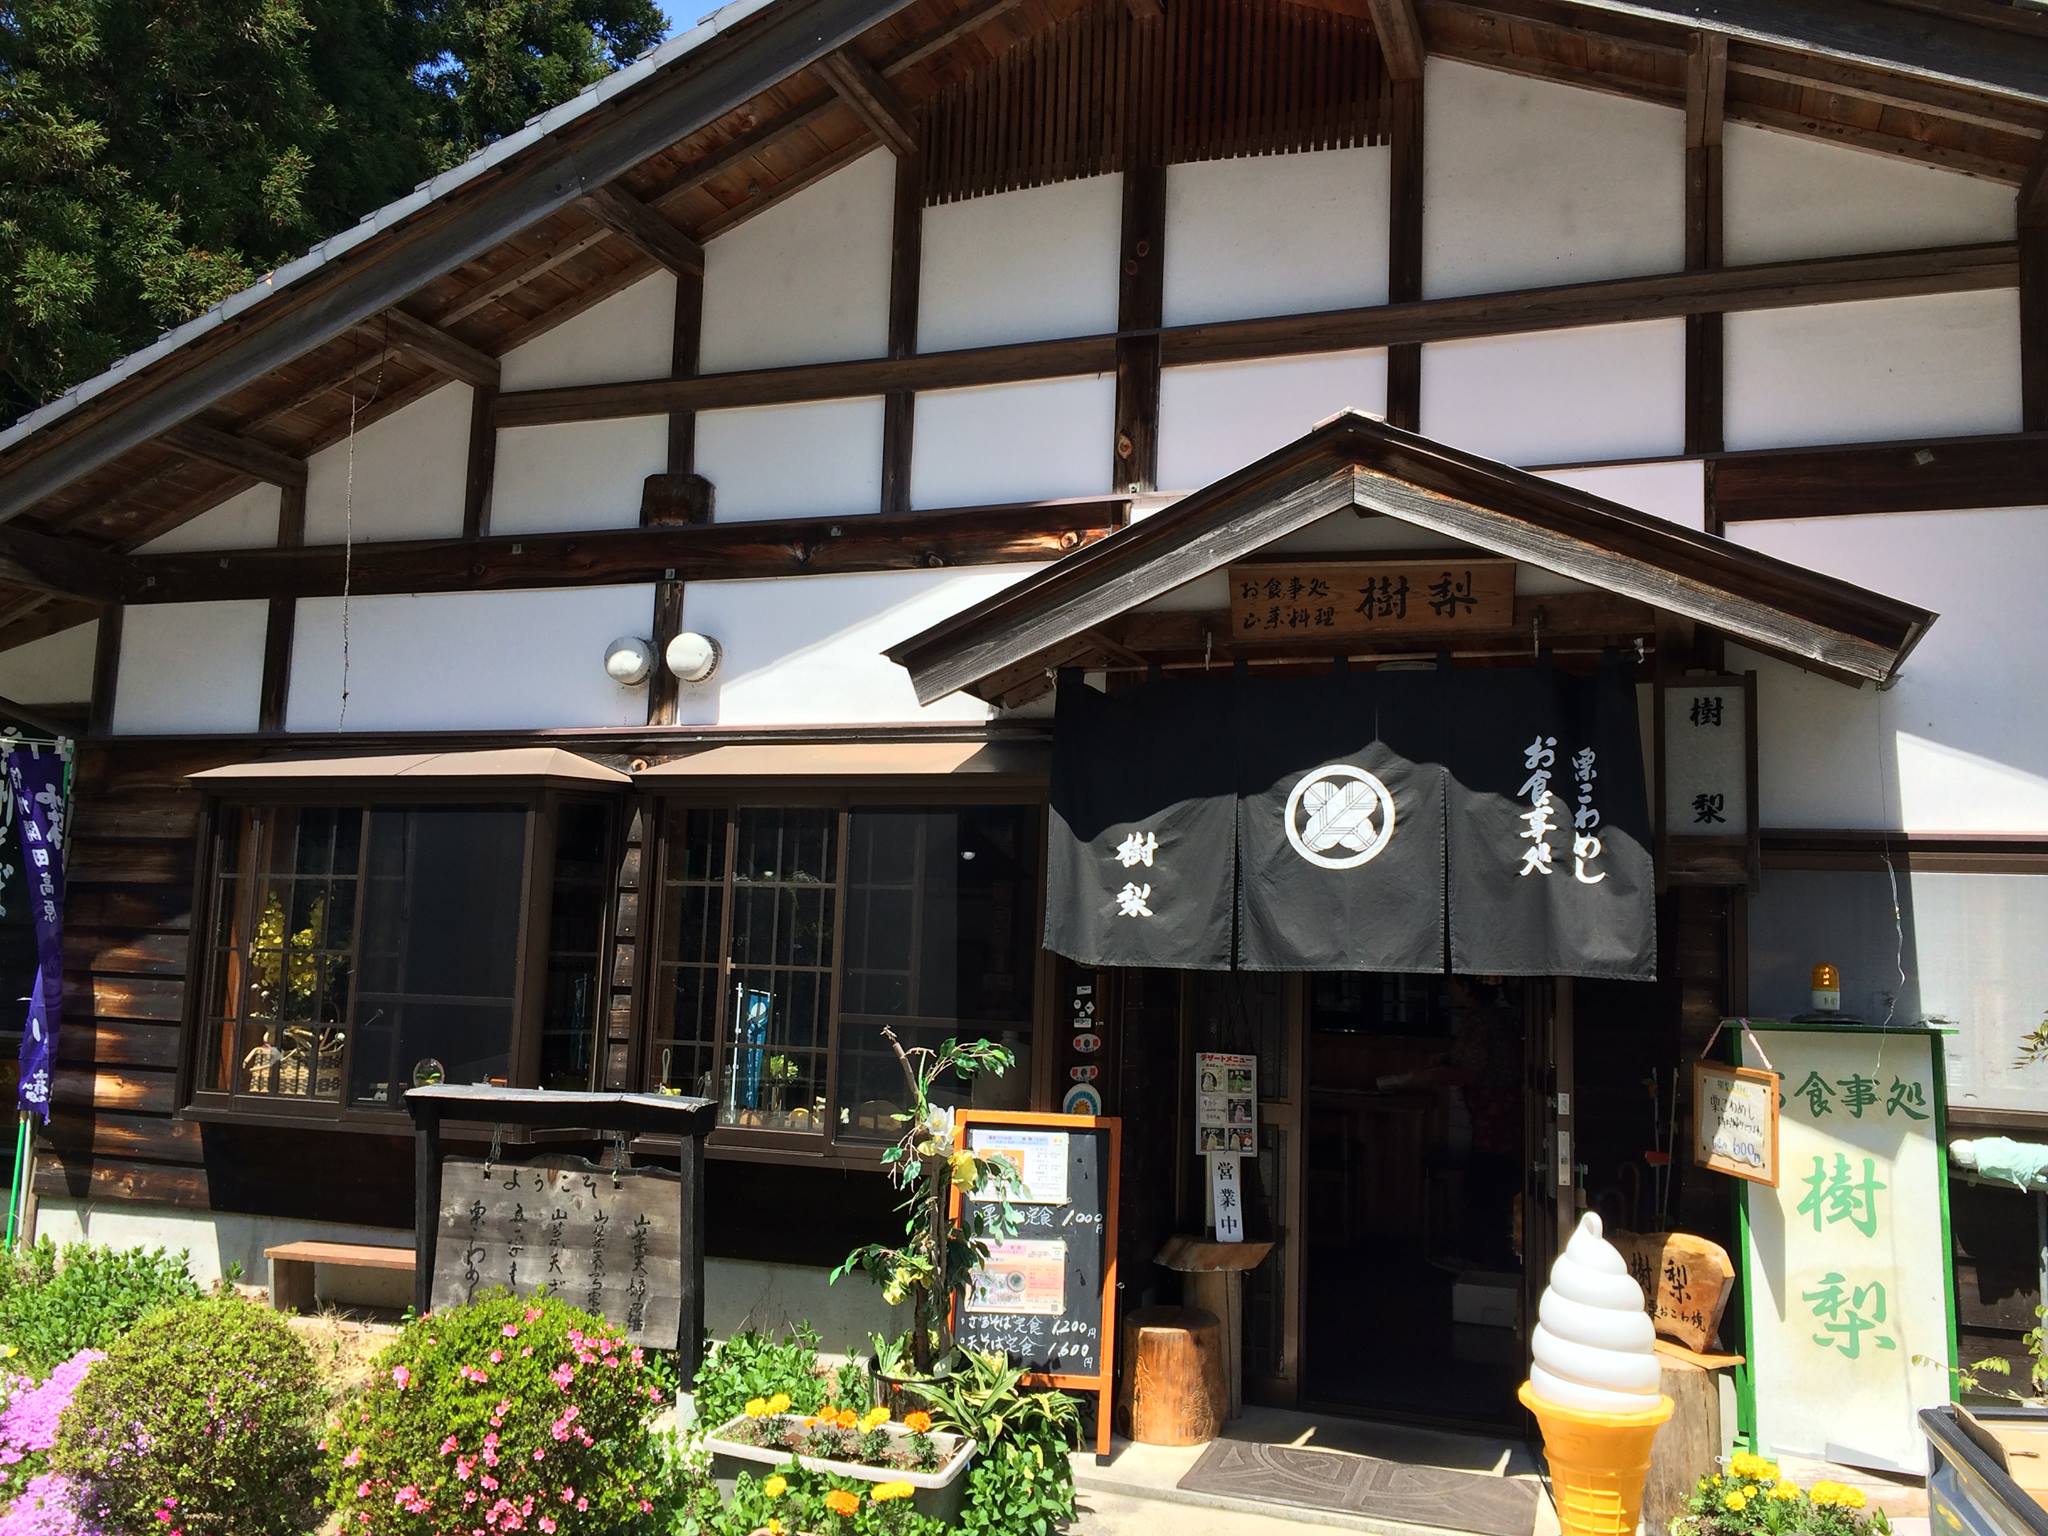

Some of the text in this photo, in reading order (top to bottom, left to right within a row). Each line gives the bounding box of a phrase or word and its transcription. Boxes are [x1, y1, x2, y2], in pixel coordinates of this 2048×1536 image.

[1241, 577, 1330, 600] お食事処
[1354, 571, 1478, 622] 樹梨
[1244, 607, 1335, 631] 山菜料理
[1690, 696, 1728, 825] 樹梨
[1518, 735, 1557, 878] お食事処
[1570, 747, 1606, 885] 栗こわめし
[1115, 831, 1159, 918] 樹梨
[1200, 1053, 1253, 1063] デザートメニュー
[503, 1168, 598, 1200] ようこそ
[1217, 1161, 1238, 1234] 営業中
[1631, 1252, 1692, 1305] 樹梨
[1797, 1152, 1897, 1360] 樹梨
[966, 1333, 1042, 1357] 天そば定食
[967, 1314, 1045, 1335] ざるそば定食
